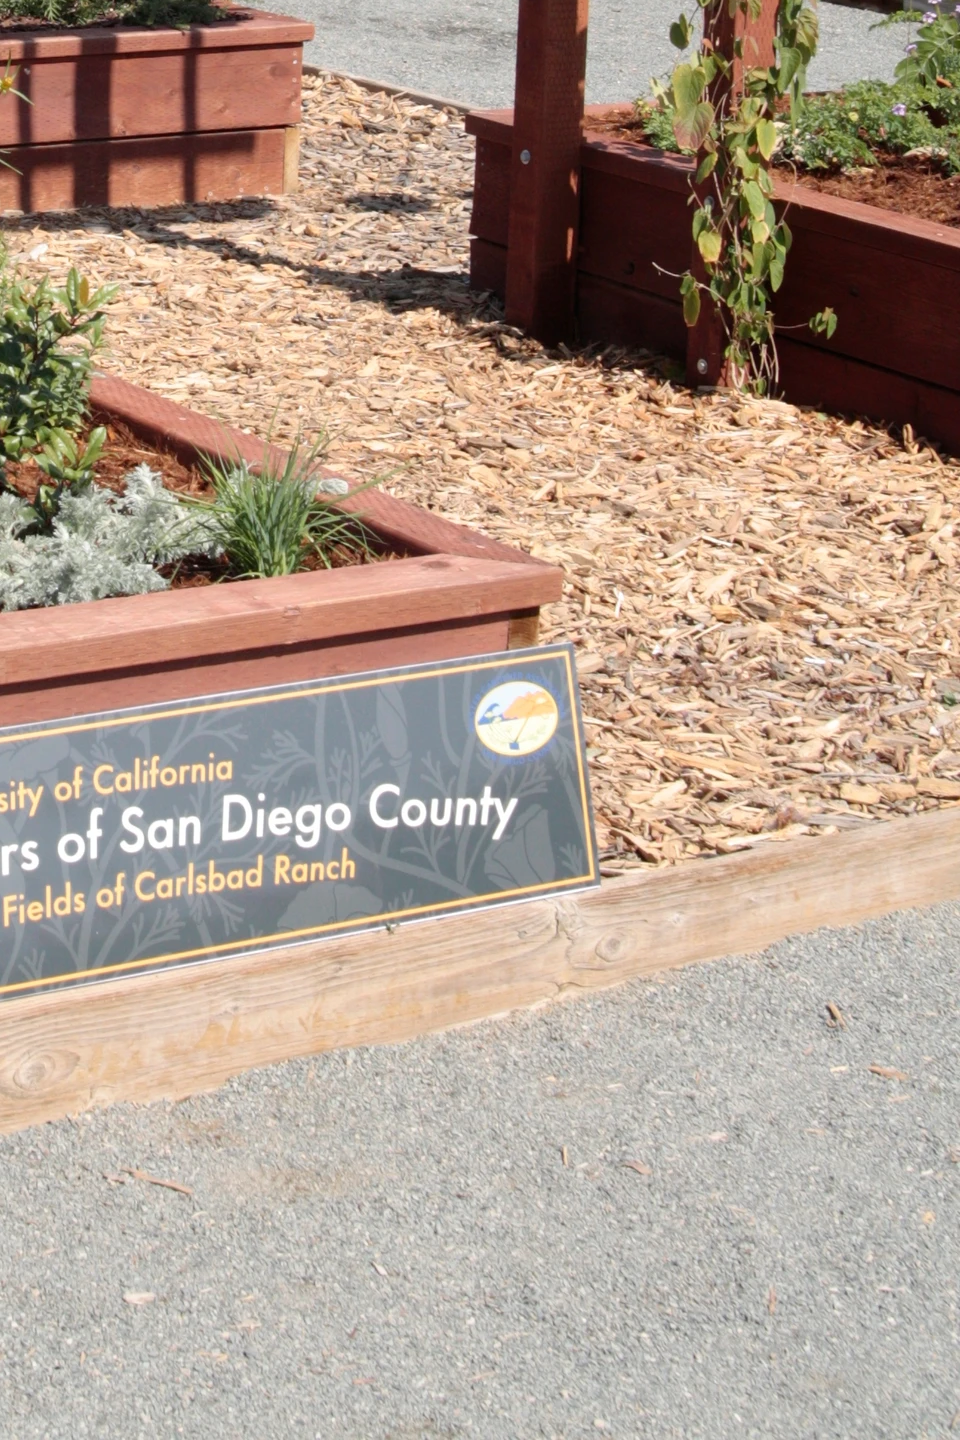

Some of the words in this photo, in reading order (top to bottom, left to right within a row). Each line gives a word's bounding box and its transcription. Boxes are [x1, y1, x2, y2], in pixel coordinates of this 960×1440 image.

[54, 765, 84, 802] of
[93, 752, 234, 796] California
[57, 806, 104, 864] of
[119, 806, 202, 854] San
[221, 792, 352, 849] Diego
[368, 782, 519, 841] County
[2, 881, 86, 928] Fields
[95, 872, 126, 909] of
[134, 854, 264, 902] Carlsbad
[274, 846, 356, 886] Ranch
